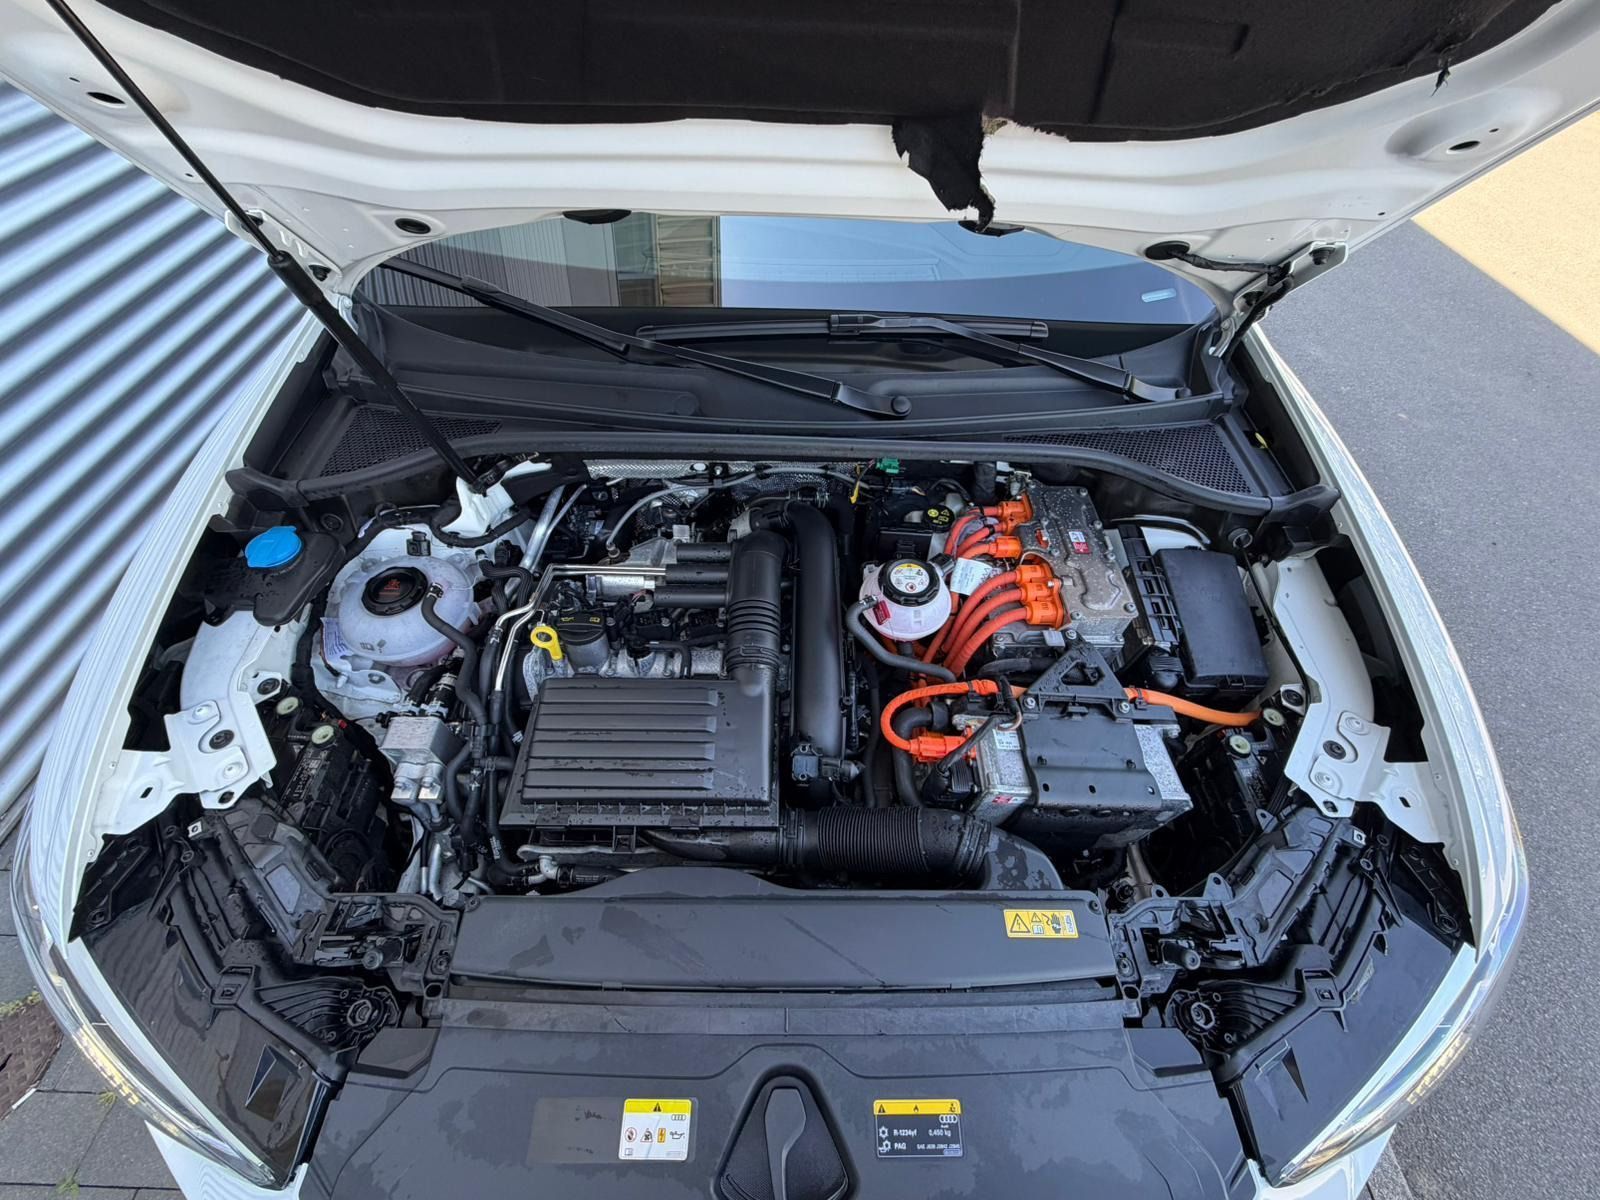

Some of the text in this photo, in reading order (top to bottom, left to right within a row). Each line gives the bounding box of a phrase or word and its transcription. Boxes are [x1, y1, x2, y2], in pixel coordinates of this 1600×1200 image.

[893, 1129, 917, 1138] R-1234yf
[944, 1129, 951, 1137] kg
[894, 1142, 907, 1150] PAG
